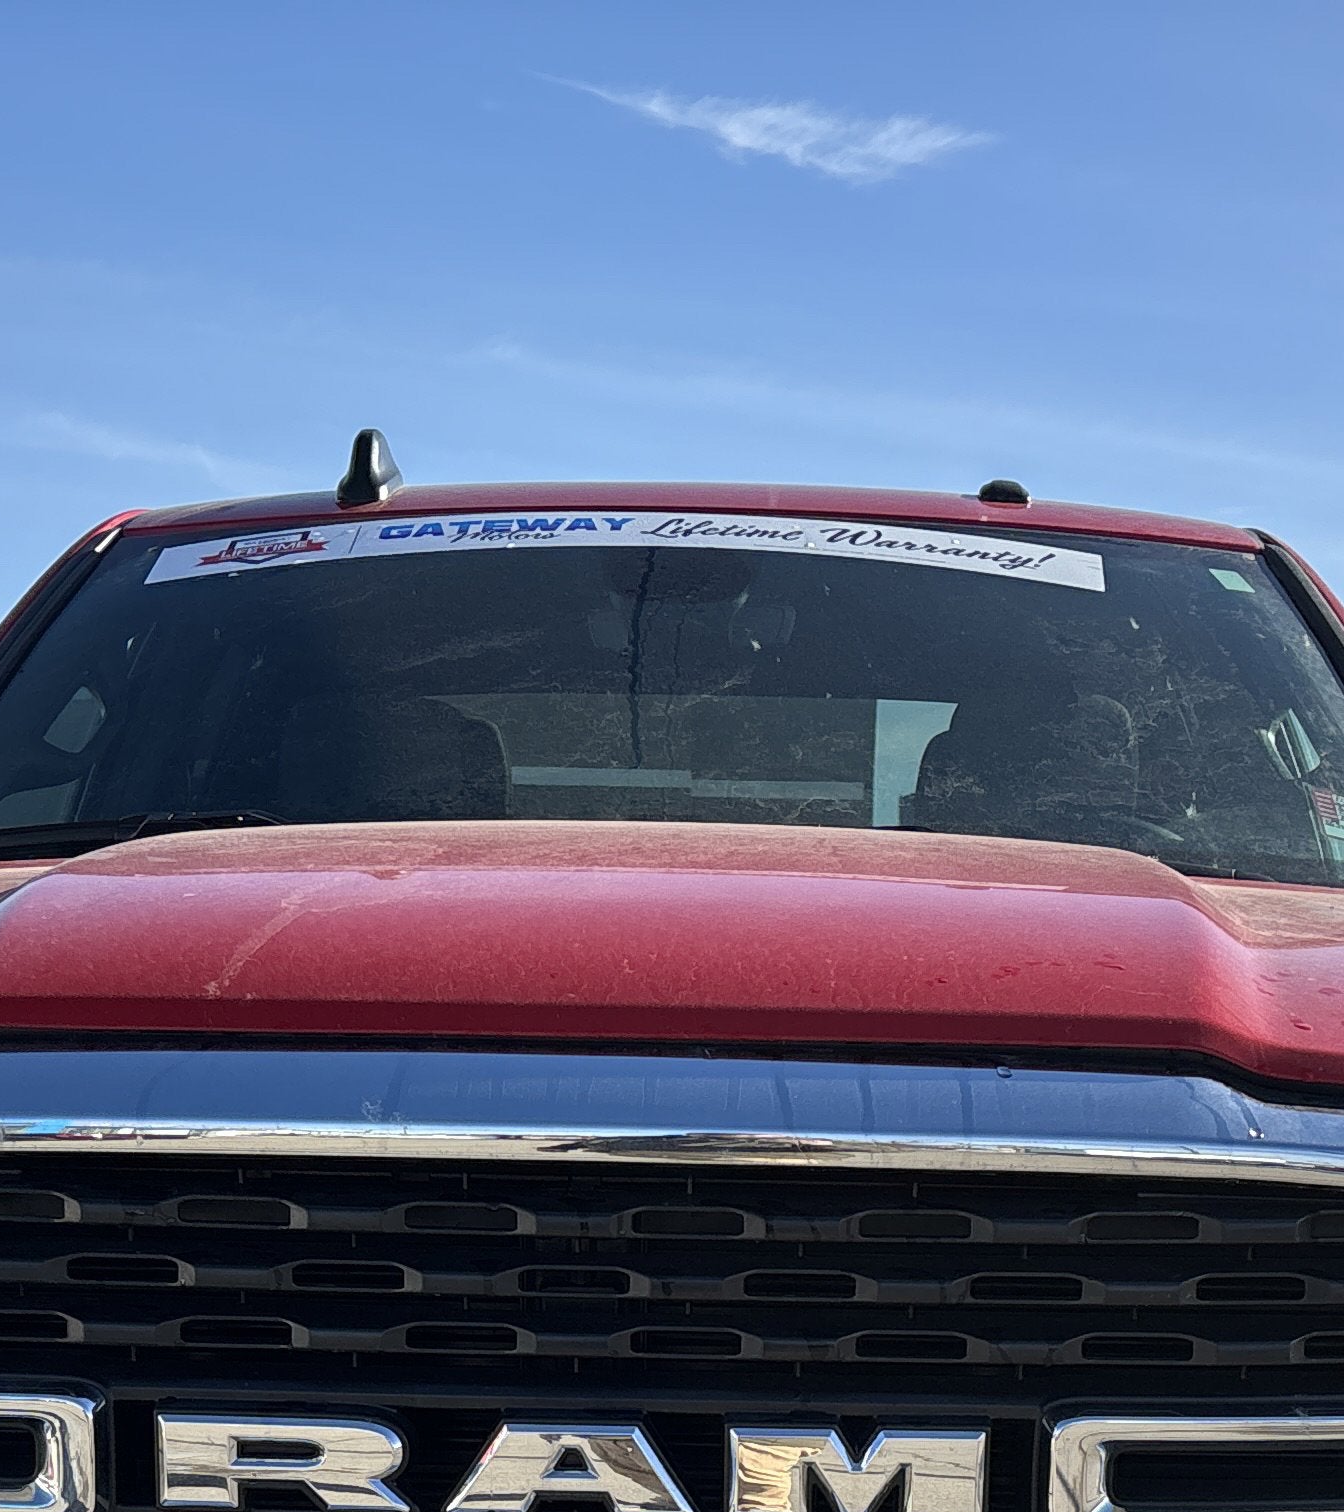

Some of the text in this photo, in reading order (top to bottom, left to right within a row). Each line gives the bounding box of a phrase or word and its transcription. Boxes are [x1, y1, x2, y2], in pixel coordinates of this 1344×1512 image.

[379, 517, 636, 540] GATEWAY
[449, 527, 562, 544] Motors
[640, 518, 1056, 570] Lifetime Warranty!
